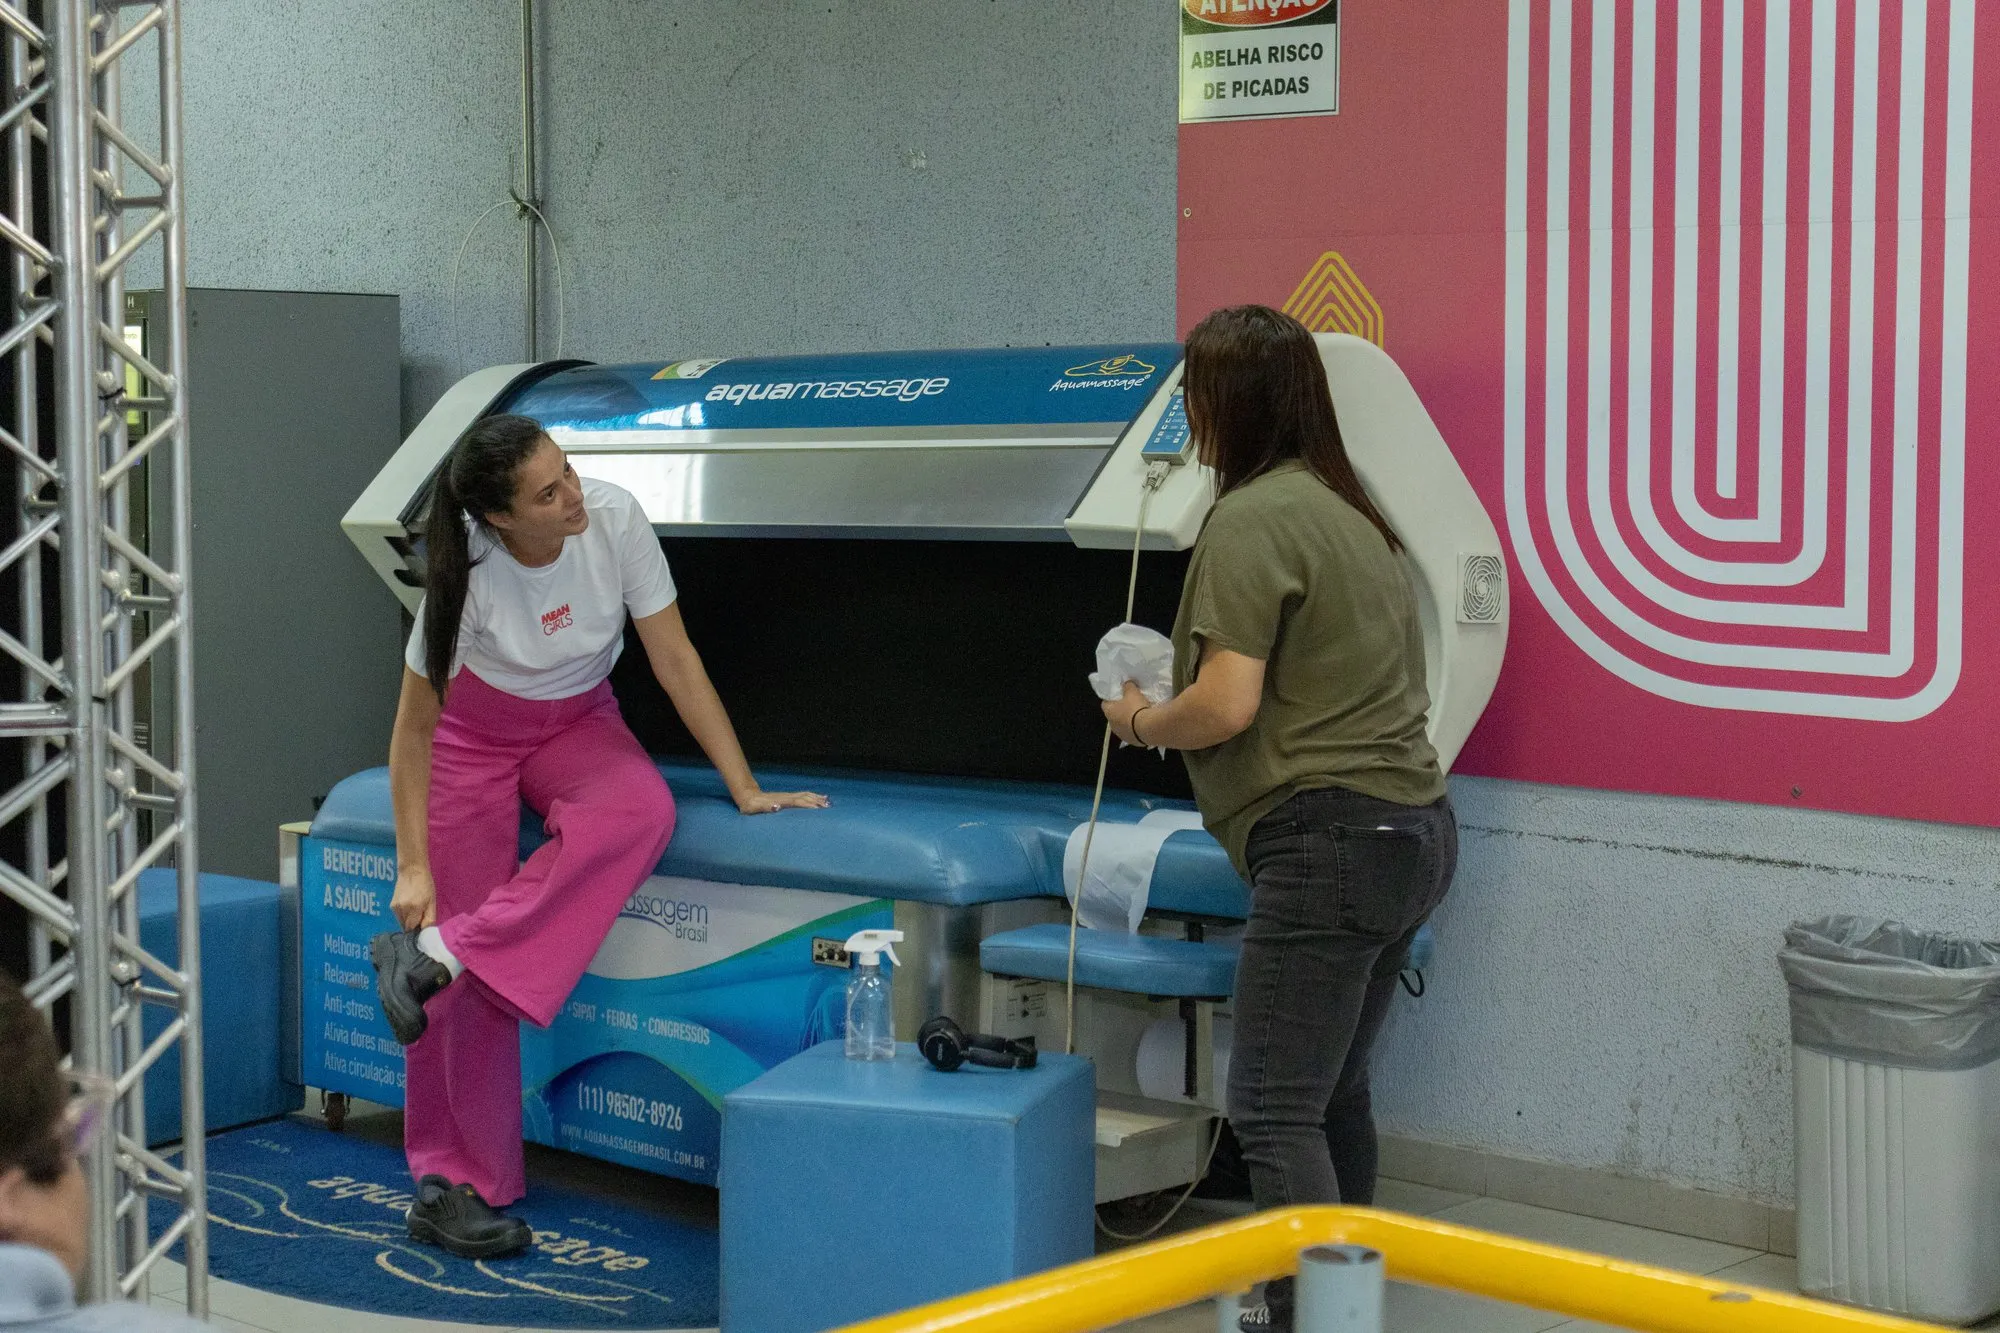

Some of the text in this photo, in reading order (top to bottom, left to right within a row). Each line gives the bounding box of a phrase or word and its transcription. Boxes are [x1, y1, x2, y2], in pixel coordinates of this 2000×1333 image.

[1191, 43, 1324, 69] ABELHA RISCO
[1204, 76, 1310, 100] DE PICADAS
[705, 377, 950, 406] aquamassage
[541, 603, 571, 625] MEAN
[543, 613, 574, 636] GIRLS
[323, 847, 395, 882] BENEFÍCIOS
[323, 884, 381, 917] A SAÚDE:
[324, 933, 361, 959] Melhora
[675, 922, 708, 943] Brasil
[324, 962, 369, 990] Relaxante
[324, 991, 375, 1021] Anti-stress
[324, 1021, 349, 1045] Alivia
[351, 1027, 376, 1051] dores
[572, 1001, 597, 1023] SIPAT
[606, 1008, 638, 1031] FEIRAS
[648, 1015, 710, 1046] CONGRESSOS
[324, 1050, 347, 1074] Ativa
[348, 1057, 395, 1086] circulação
[578, 1081, 683, 1132] (11) 98502-8926
